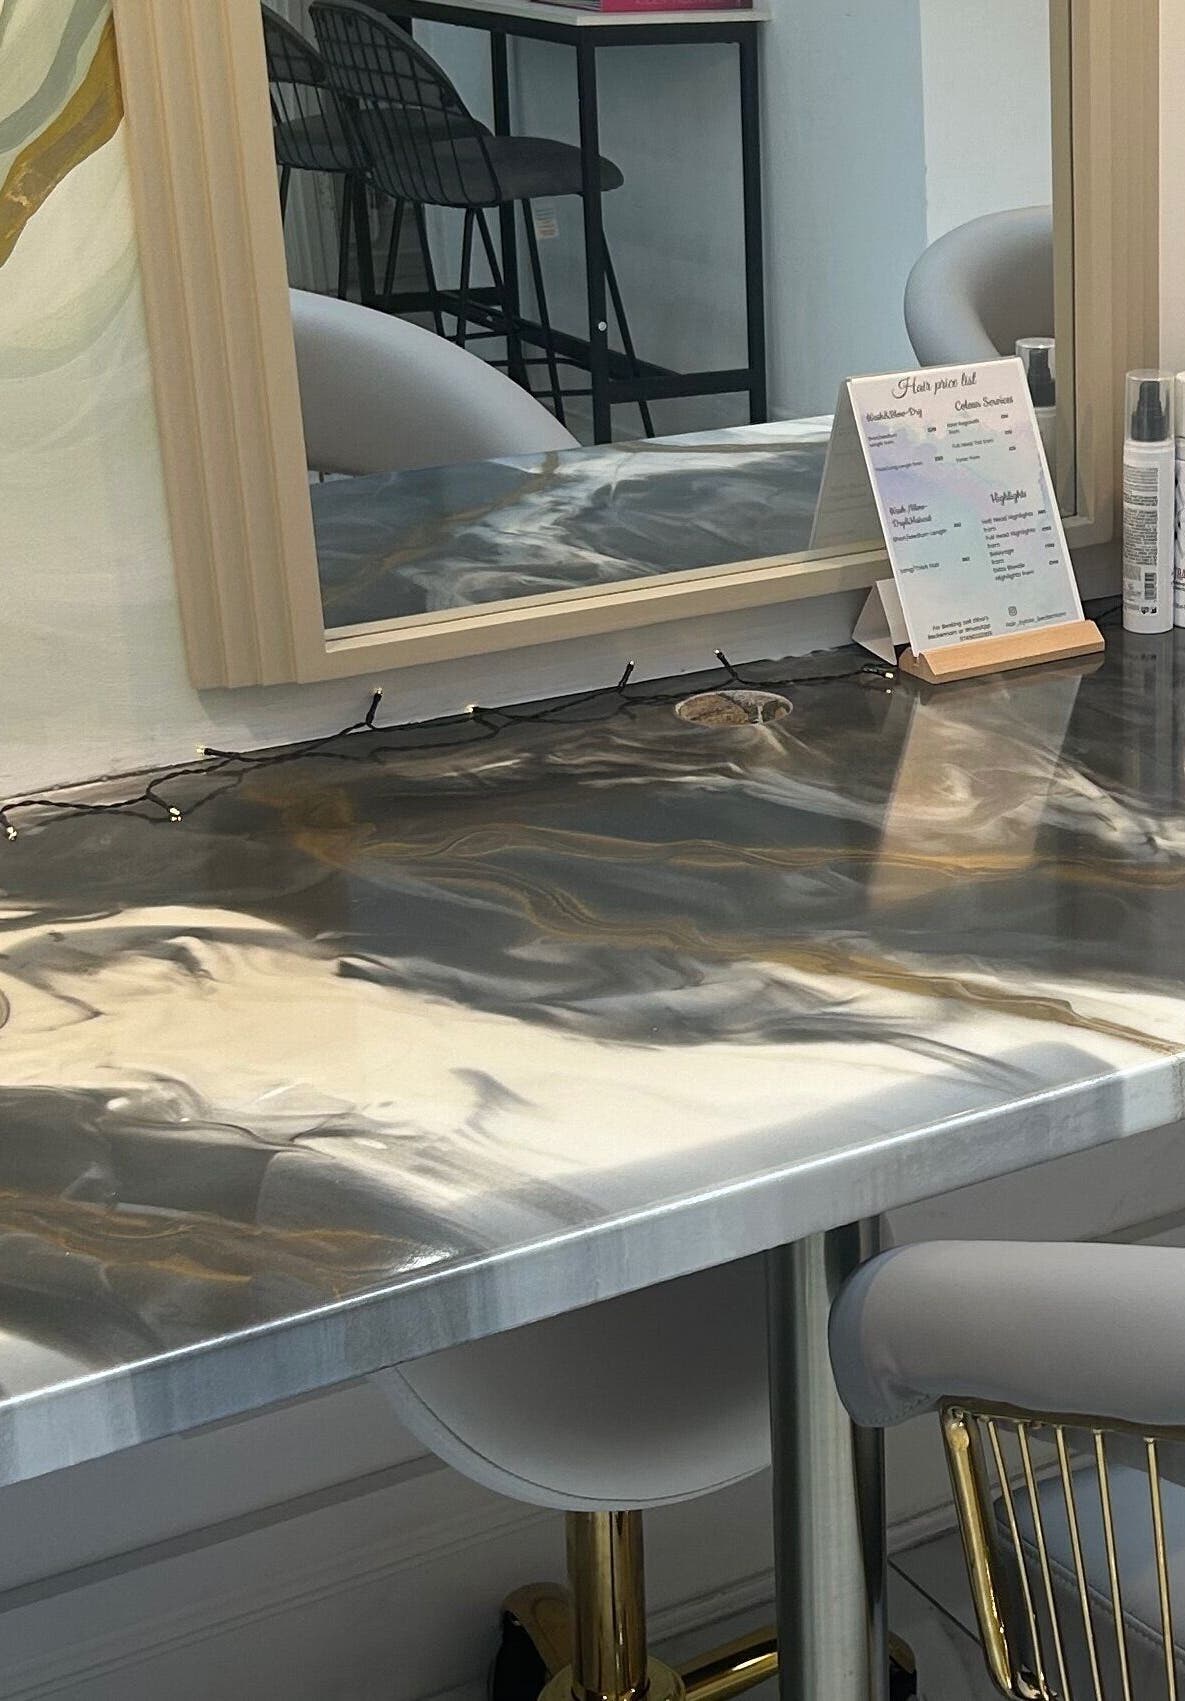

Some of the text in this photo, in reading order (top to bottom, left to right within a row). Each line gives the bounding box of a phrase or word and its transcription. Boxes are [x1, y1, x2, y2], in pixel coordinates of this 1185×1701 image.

[891, 371, 978, 399] Hair price list
[990, 490, 1027, 506] Highlights
